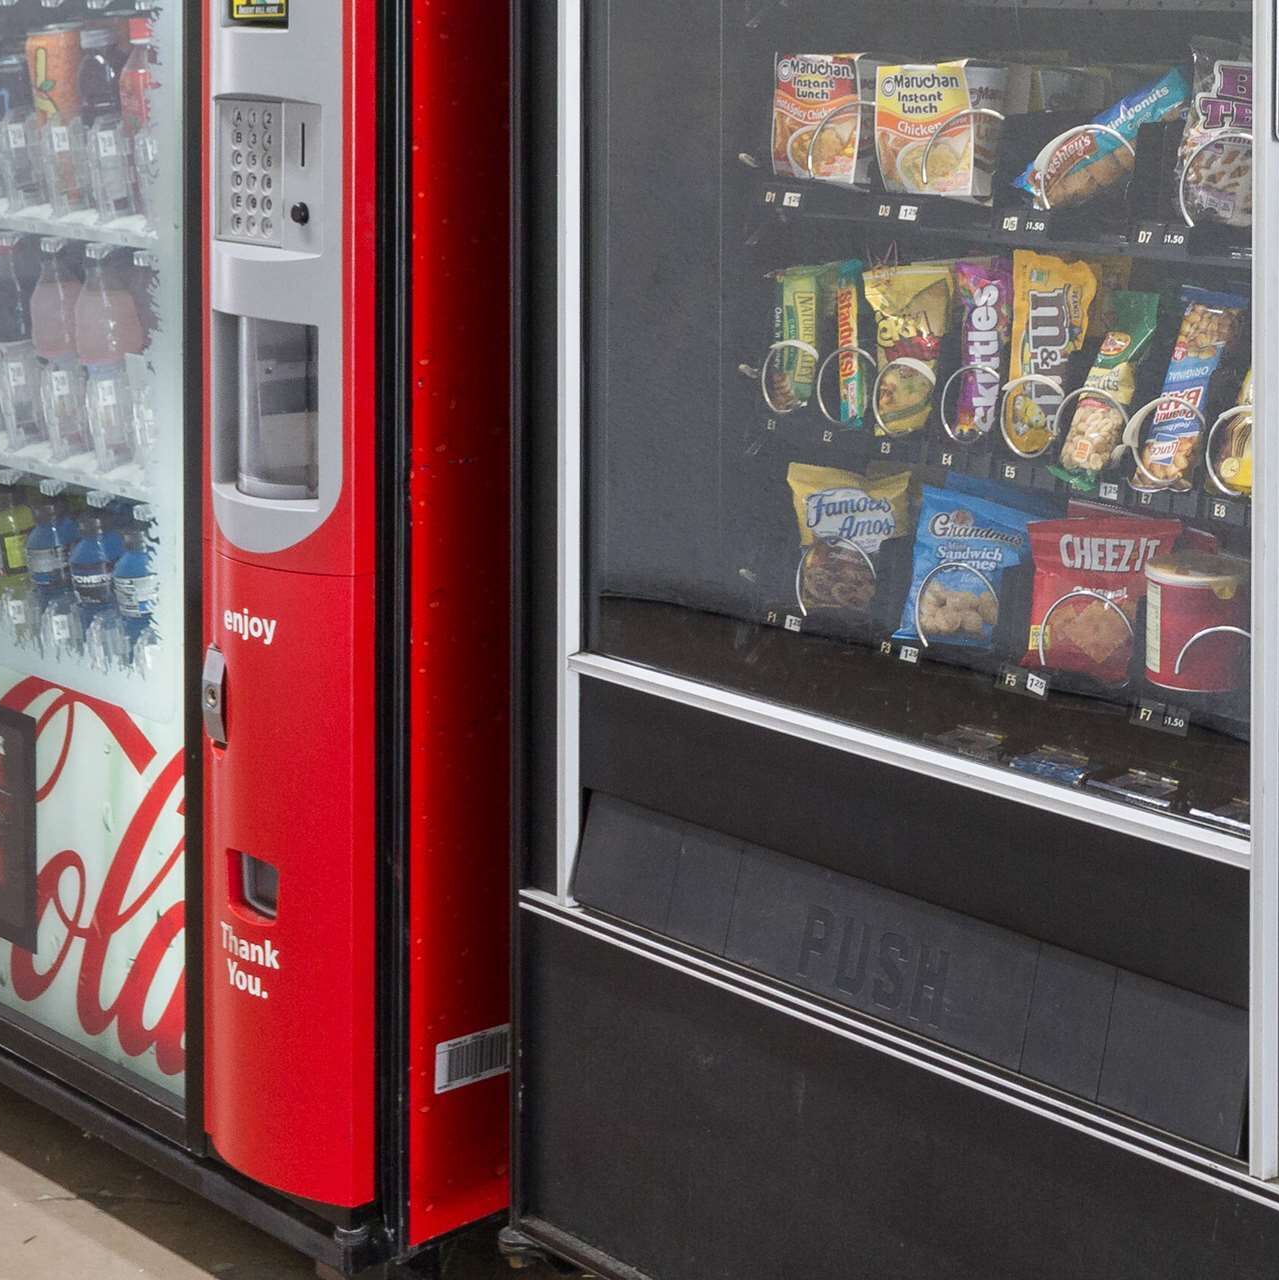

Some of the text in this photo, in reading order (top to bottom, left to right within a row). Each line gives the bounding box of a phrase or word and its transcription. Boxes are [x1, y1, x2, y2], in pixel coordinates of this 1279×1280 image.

[790, 59, 851, 79] Maruchan
[793, 77, 836, 90] Instant
[894, 73, 960, 90] Maruchan
[796, 88, 830, 101] Lunch
[897, 91, 943, 103] Instant
[902, 102, 939, 115] Lunch
[898, 120, 943, 137] Chicken
[765, 192, 776, 204] D1
[878, 204, 890, 216] D3
[1137, 230, 1153, 244] D7
[774, 307, 783, 329] Oats
[797, 295, 815, 379] NATURE VLLEY
[1166, 365, 1210, 383] ORIGINAL
[823, 430, 833, 442] E2
[880, 442, 891, 454] E3
[1150, 440, 1180, 458] Lance
[941, 453, 953, 467] E4
[1004, 465, 1016, 479] E5
[1141, 492, 1153, 505] E7
[807, 494, 892, 528] Famous
[1214, 504, 1226, 518] E8
[830, 516, 896, 546] Amos
[930, 512, 1023, 546] Grandma's
[935, 545, 1003, 562] Sandwich
[939, 558, 998, 573] Cmes
[767, 611, 777, 623] F1
[223, 608, 277, 645] enjoy
[880, 641, 892, 654] F3
[1005, 673, 1017, 687] F5
[1139, 707, 1153, 721] F7
[220, 920, 280, 970] Thank
[794, 903, 950, 1028] PUSH
[227, 959, 269, 999] You.
